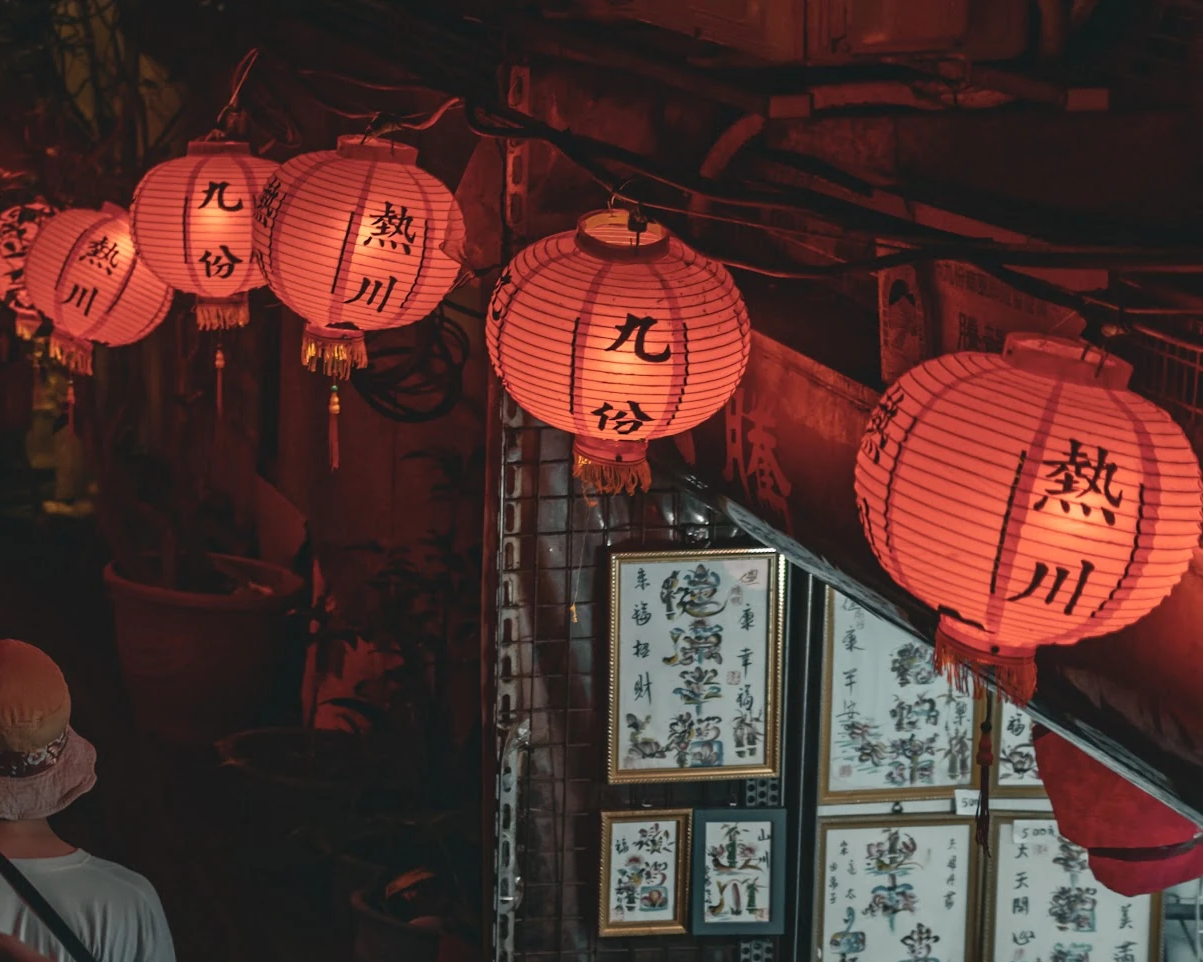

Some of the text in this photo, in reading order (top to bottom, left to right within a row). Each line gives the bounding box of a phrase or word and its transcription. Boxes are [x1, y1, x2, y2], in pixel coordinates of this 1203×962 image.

[61, 235, 118, 317] 熱川
[197, 181, 244, 280] 九份
[344, 200, 418, 313] 熱川
[591, 313, 674, 436] 九份
[1006, 438, 1123, 616] 熱川
